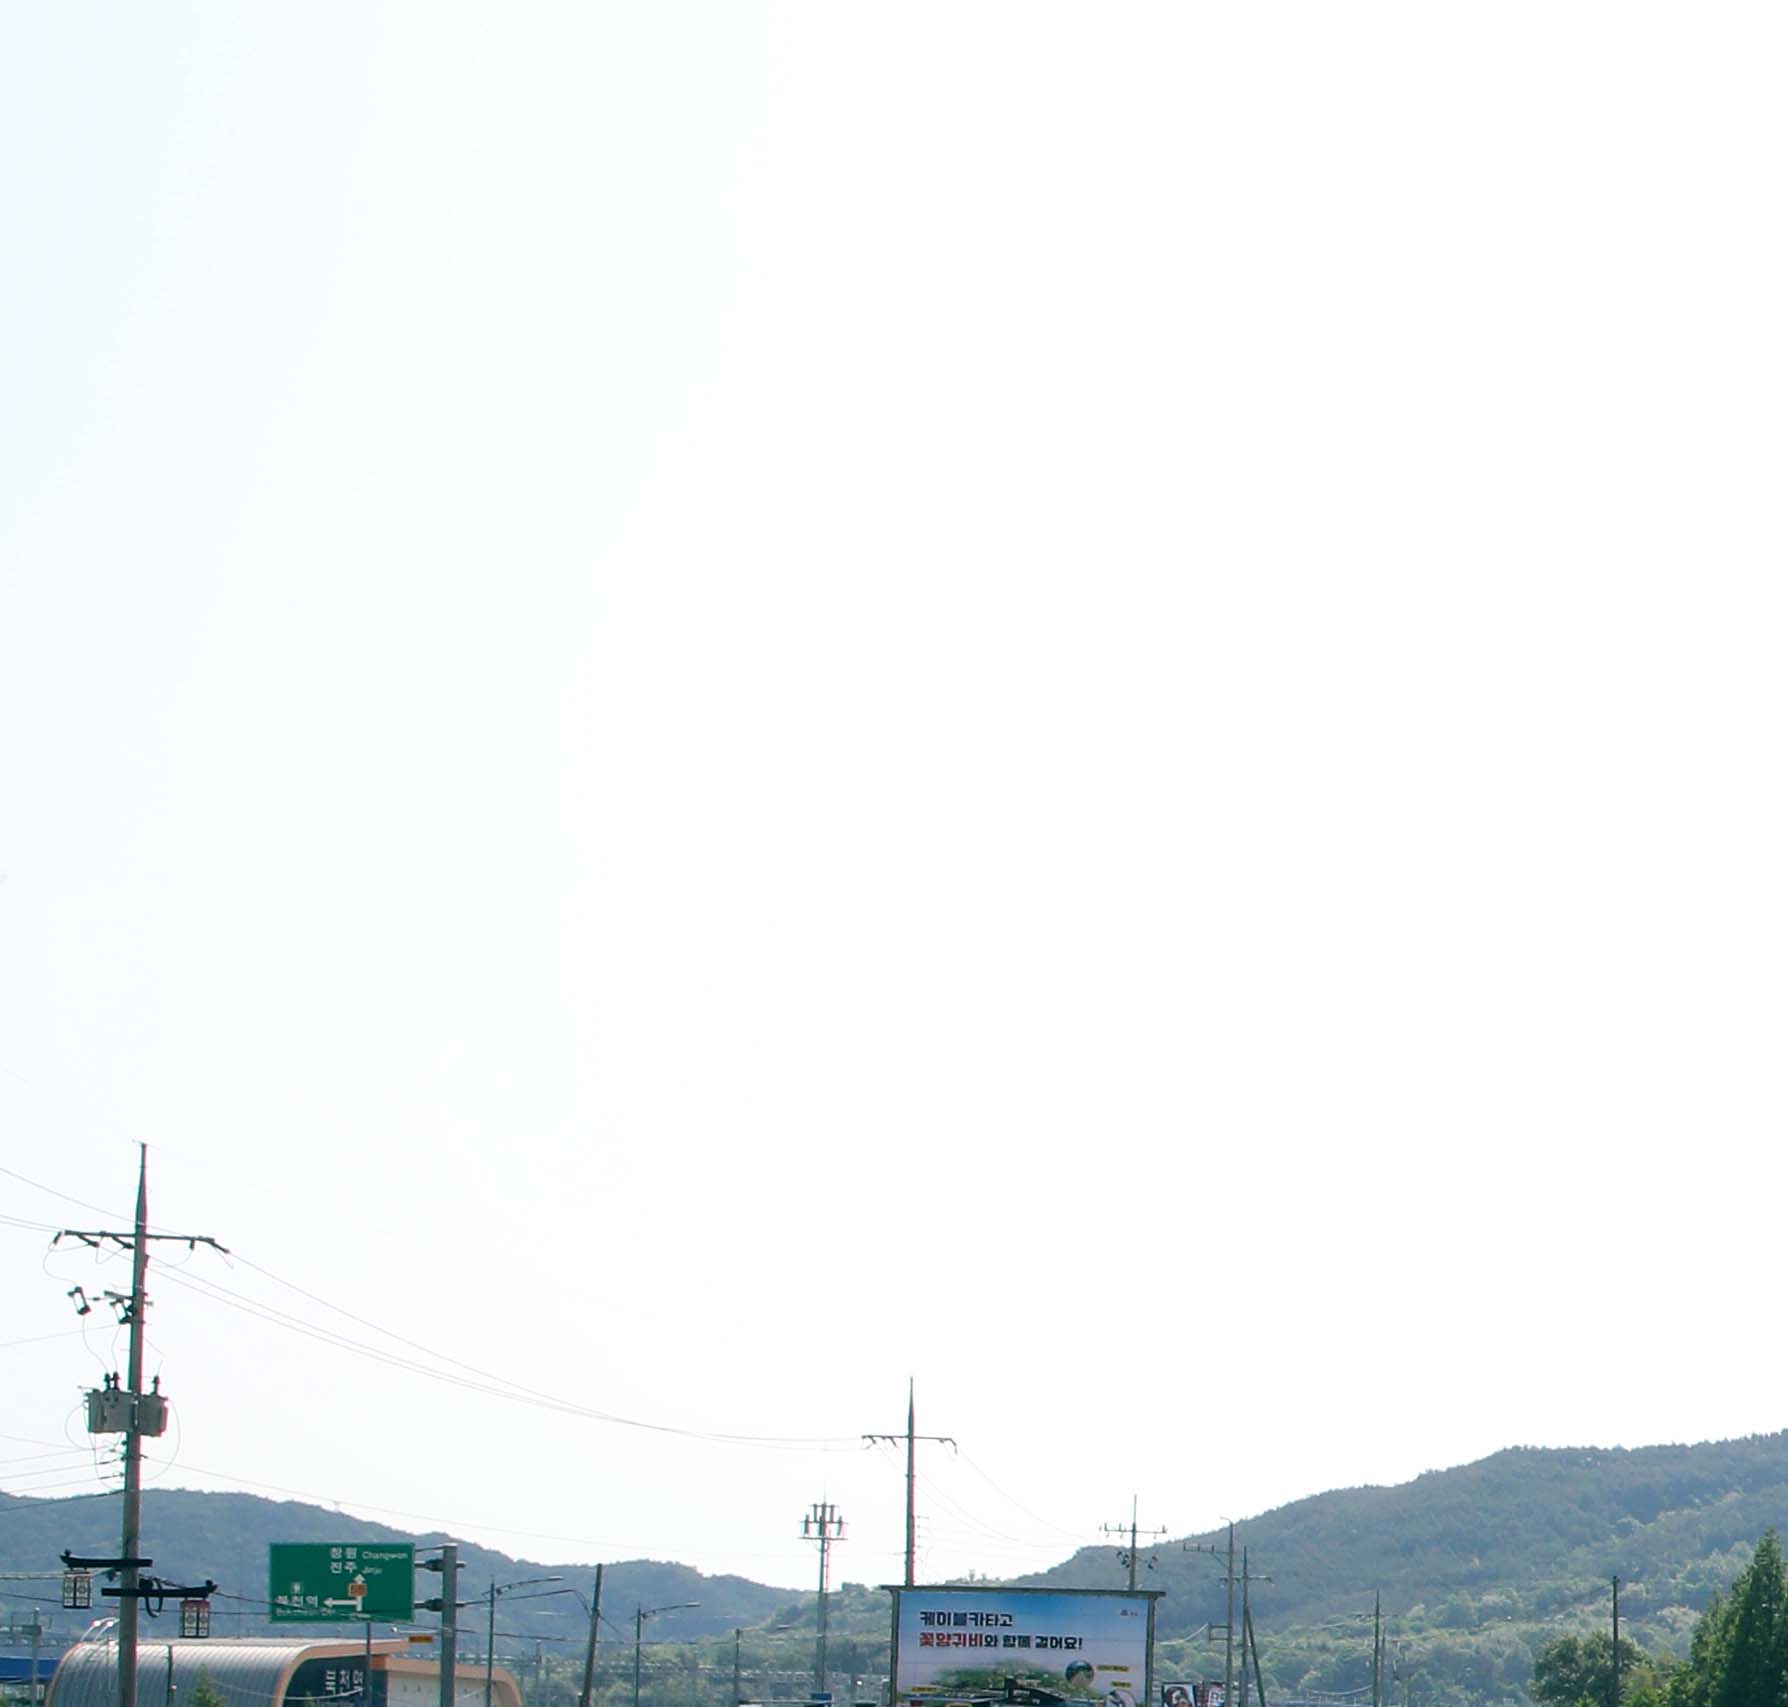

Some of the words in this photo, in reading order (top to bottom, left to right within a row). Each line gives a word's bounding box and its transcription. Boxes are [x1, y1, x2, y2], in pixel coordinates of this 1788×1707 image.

[330, 1561, 357, 1574] 진주
[920, 1632, 998, 1648] 꽃양귀비와
[1003, 1635, 1031, 1649] 함께
